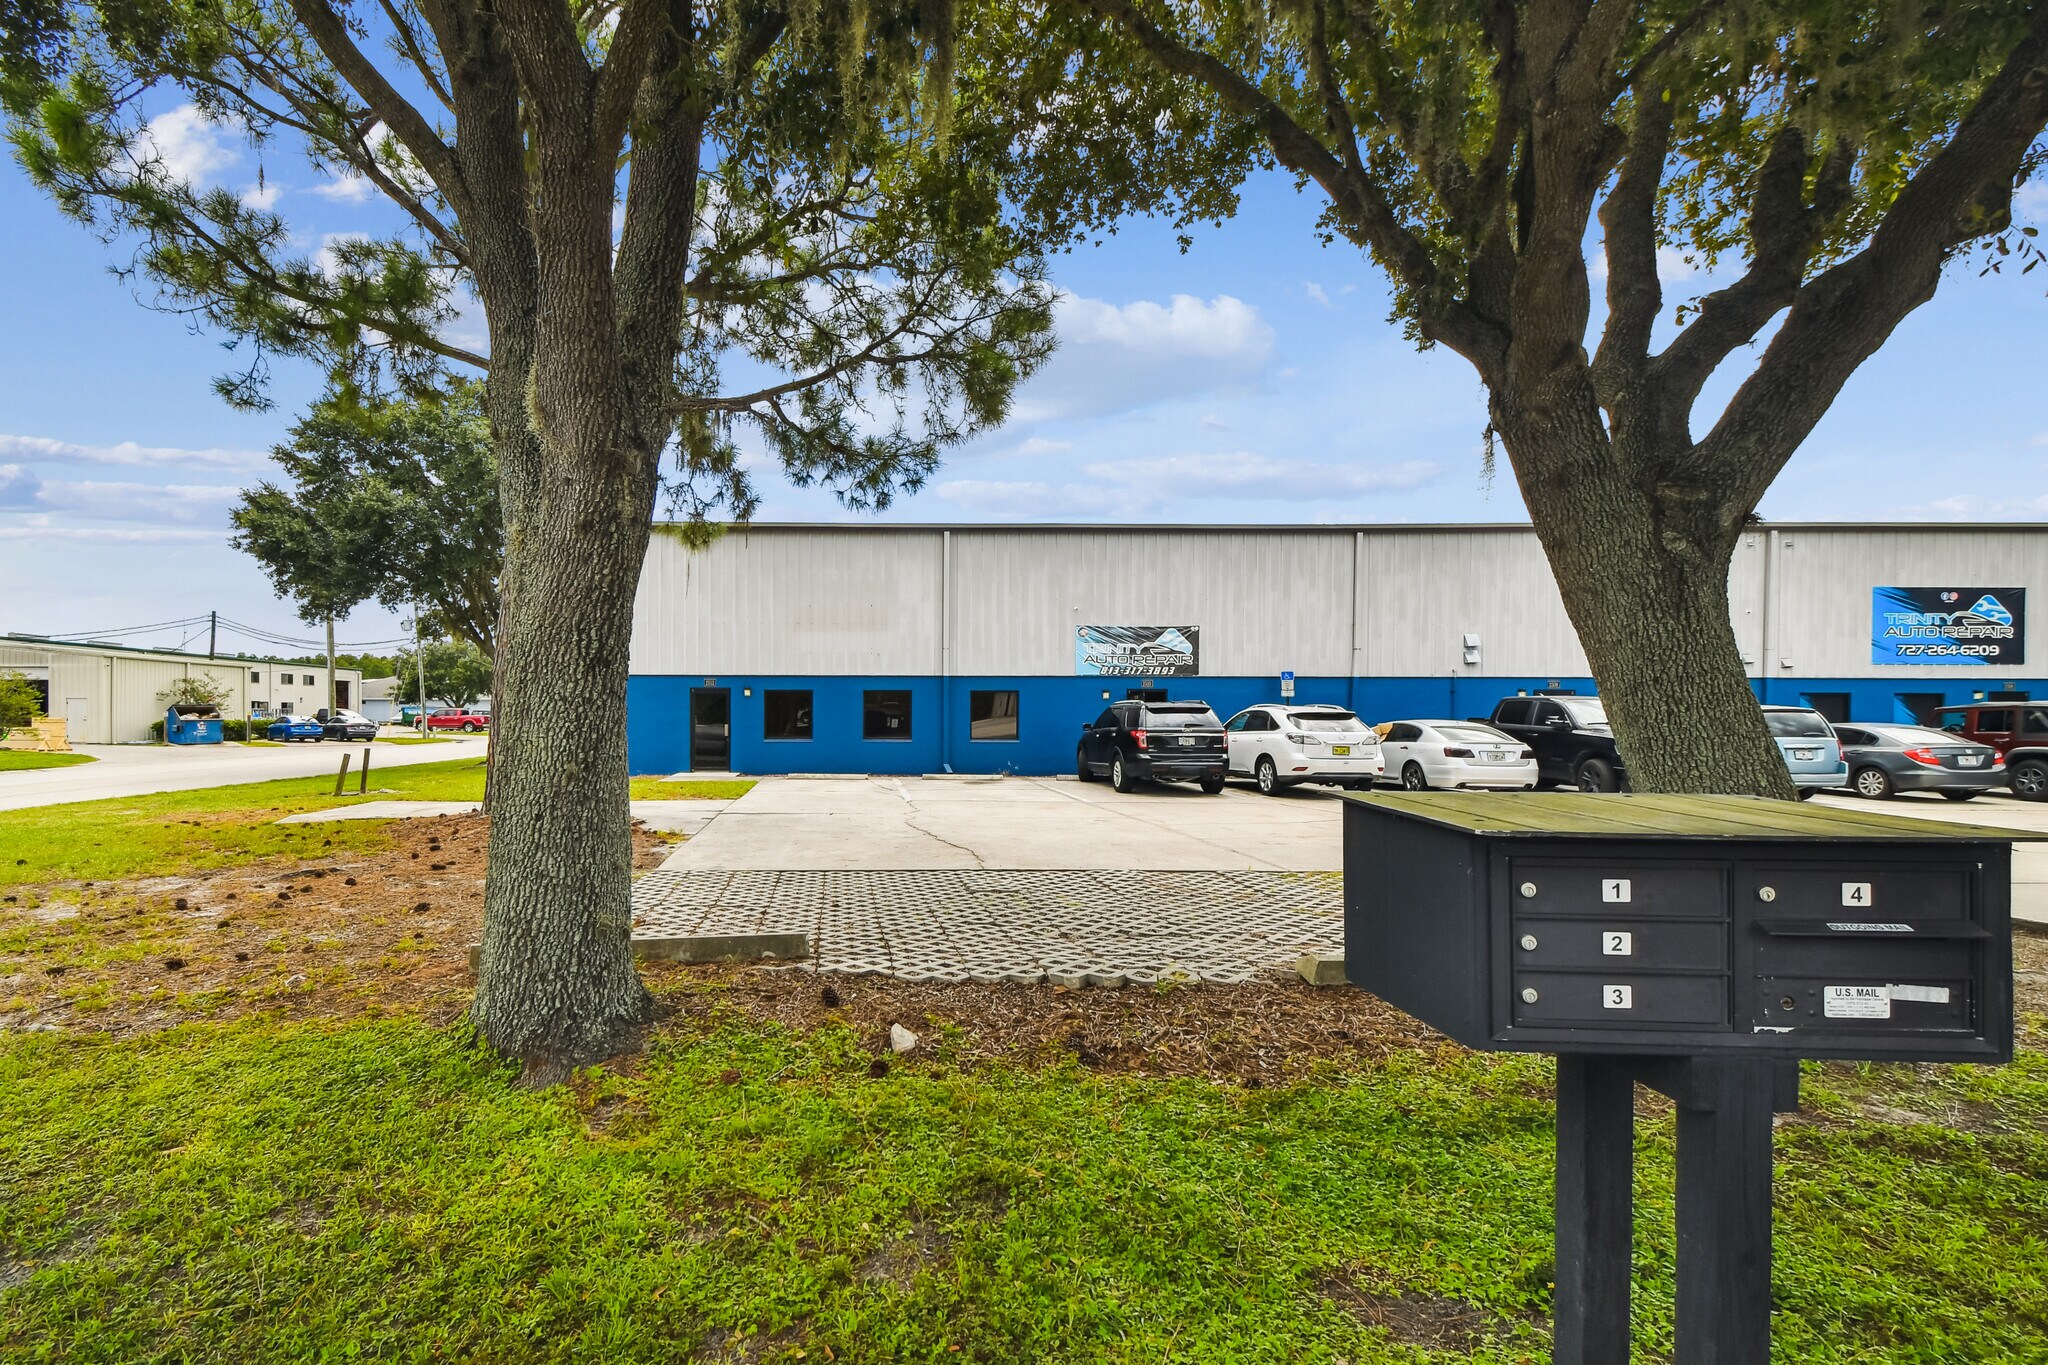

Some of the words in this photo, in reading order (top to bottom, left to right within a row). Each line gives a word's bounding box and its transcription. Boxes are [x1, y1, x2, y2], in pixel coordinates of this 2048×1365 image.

[1883, 612, 1957, 625] TRINITY
[1883, 626, 1938, 638] AUTO
[1942, 626, 2014, 639] REPAIR
[1897, 644, 2000, 656] 727-264-6209
[1083, 654, 1128, 665] AUTO
[1131, 654, 1193, 666] REPAIR
[1100, 666, 1176, 675] 813-317-3893
[1611, 882, 1620, 899] 1
[1850, 886, 1863, 903] 4
[1829, 923, 1884, 931] OUTGOING
[1611, 936, 1623, 952] 2
[1612, 989, 1623, 1005] 3
[1835, 988, 1854, 997] U.S.
[1856, 988, 1880, 998] MAIL
